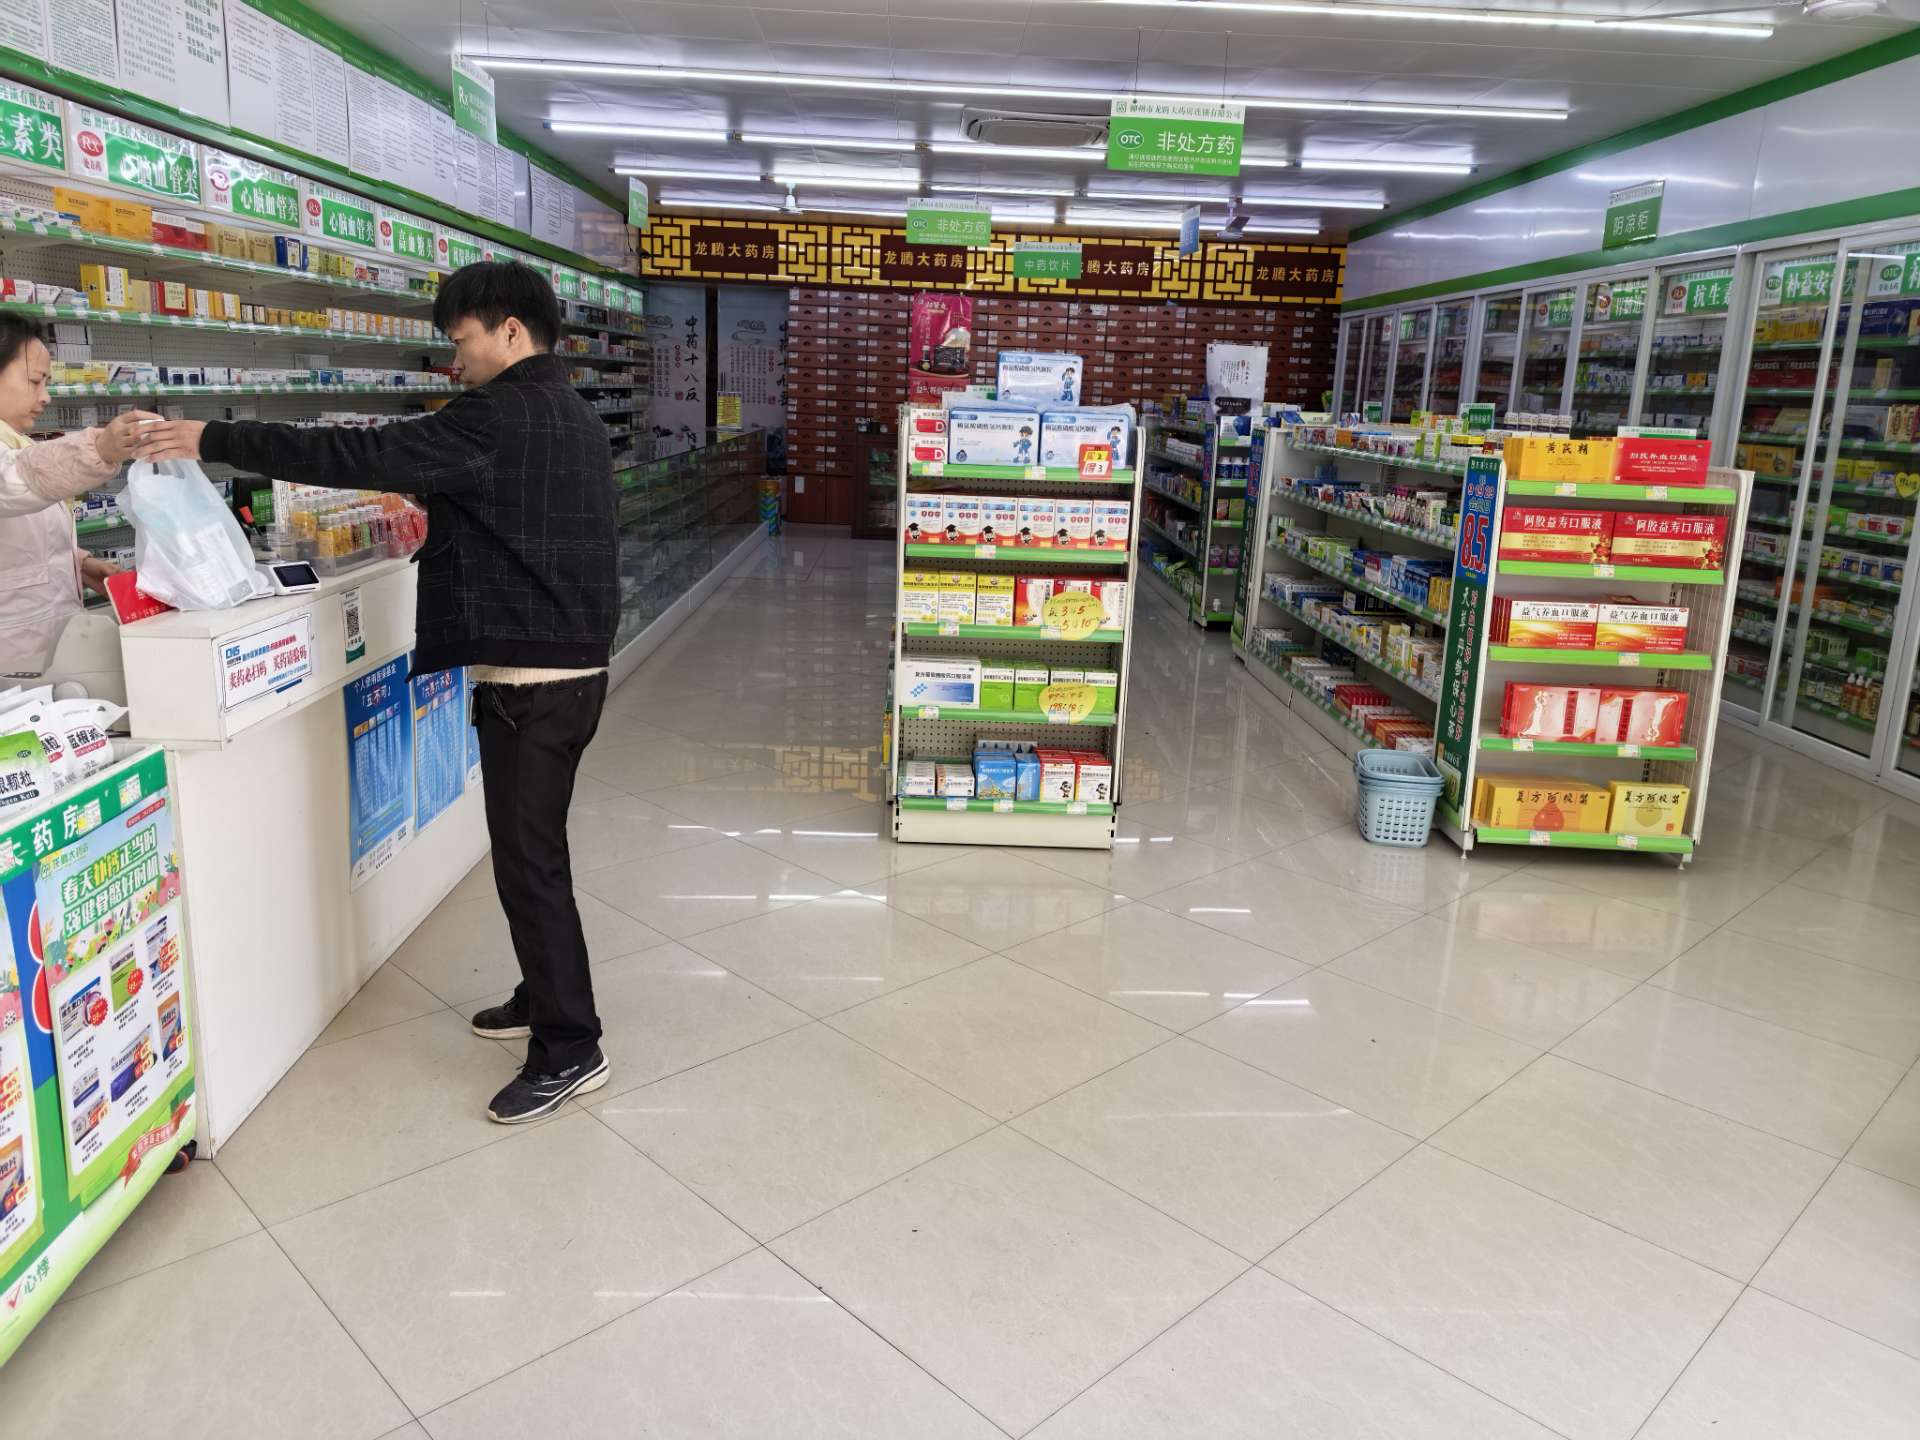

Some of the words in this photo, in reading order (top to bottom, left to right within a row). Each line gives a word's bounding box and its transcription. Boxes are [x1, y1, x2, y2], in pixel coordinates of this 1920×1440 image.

[0, 112, 64, 164] 素类
[1120, 135, 1141, 146] OTC
[1157, 130, 1237, 156] 非处方药
[241, 185, 299, 223] 心脑血管类
[328, 212, 375, 243] 心脑血管类
[936, 218, 988, 235] 非处方药
[694, 241, 777, 261] 龙腾大药房
[883, 250, 965, 269] 龙腾大药房
[1023, 258, 1072, 273] 中药饮片
[1081, 261, 1151, 278] 腾大药房
[1255, 265, 1335, 284] 龙腾大药房
[1544, 441, 1590, 456] 黄芪精
[1523, 513, 1602, 531] 阿胶益寿口服液
[1635, 518, 1715, 536] 阿胶益寿口服液
[1521, 606, 1591, 619] 益气养血口服液
[1609, 609, 1680, 623] 益气养血口服液
[1515, 789, 1590, 806] 复方阿胶浆
[1623, 789, 1681, 805] 复方阿胶浆
[62, 823, 158, 906] 春天补钙正当时
[64, 854, 161, 938] 强健骨骼好时机
[23, 1255, 51, 1296] 心悸
